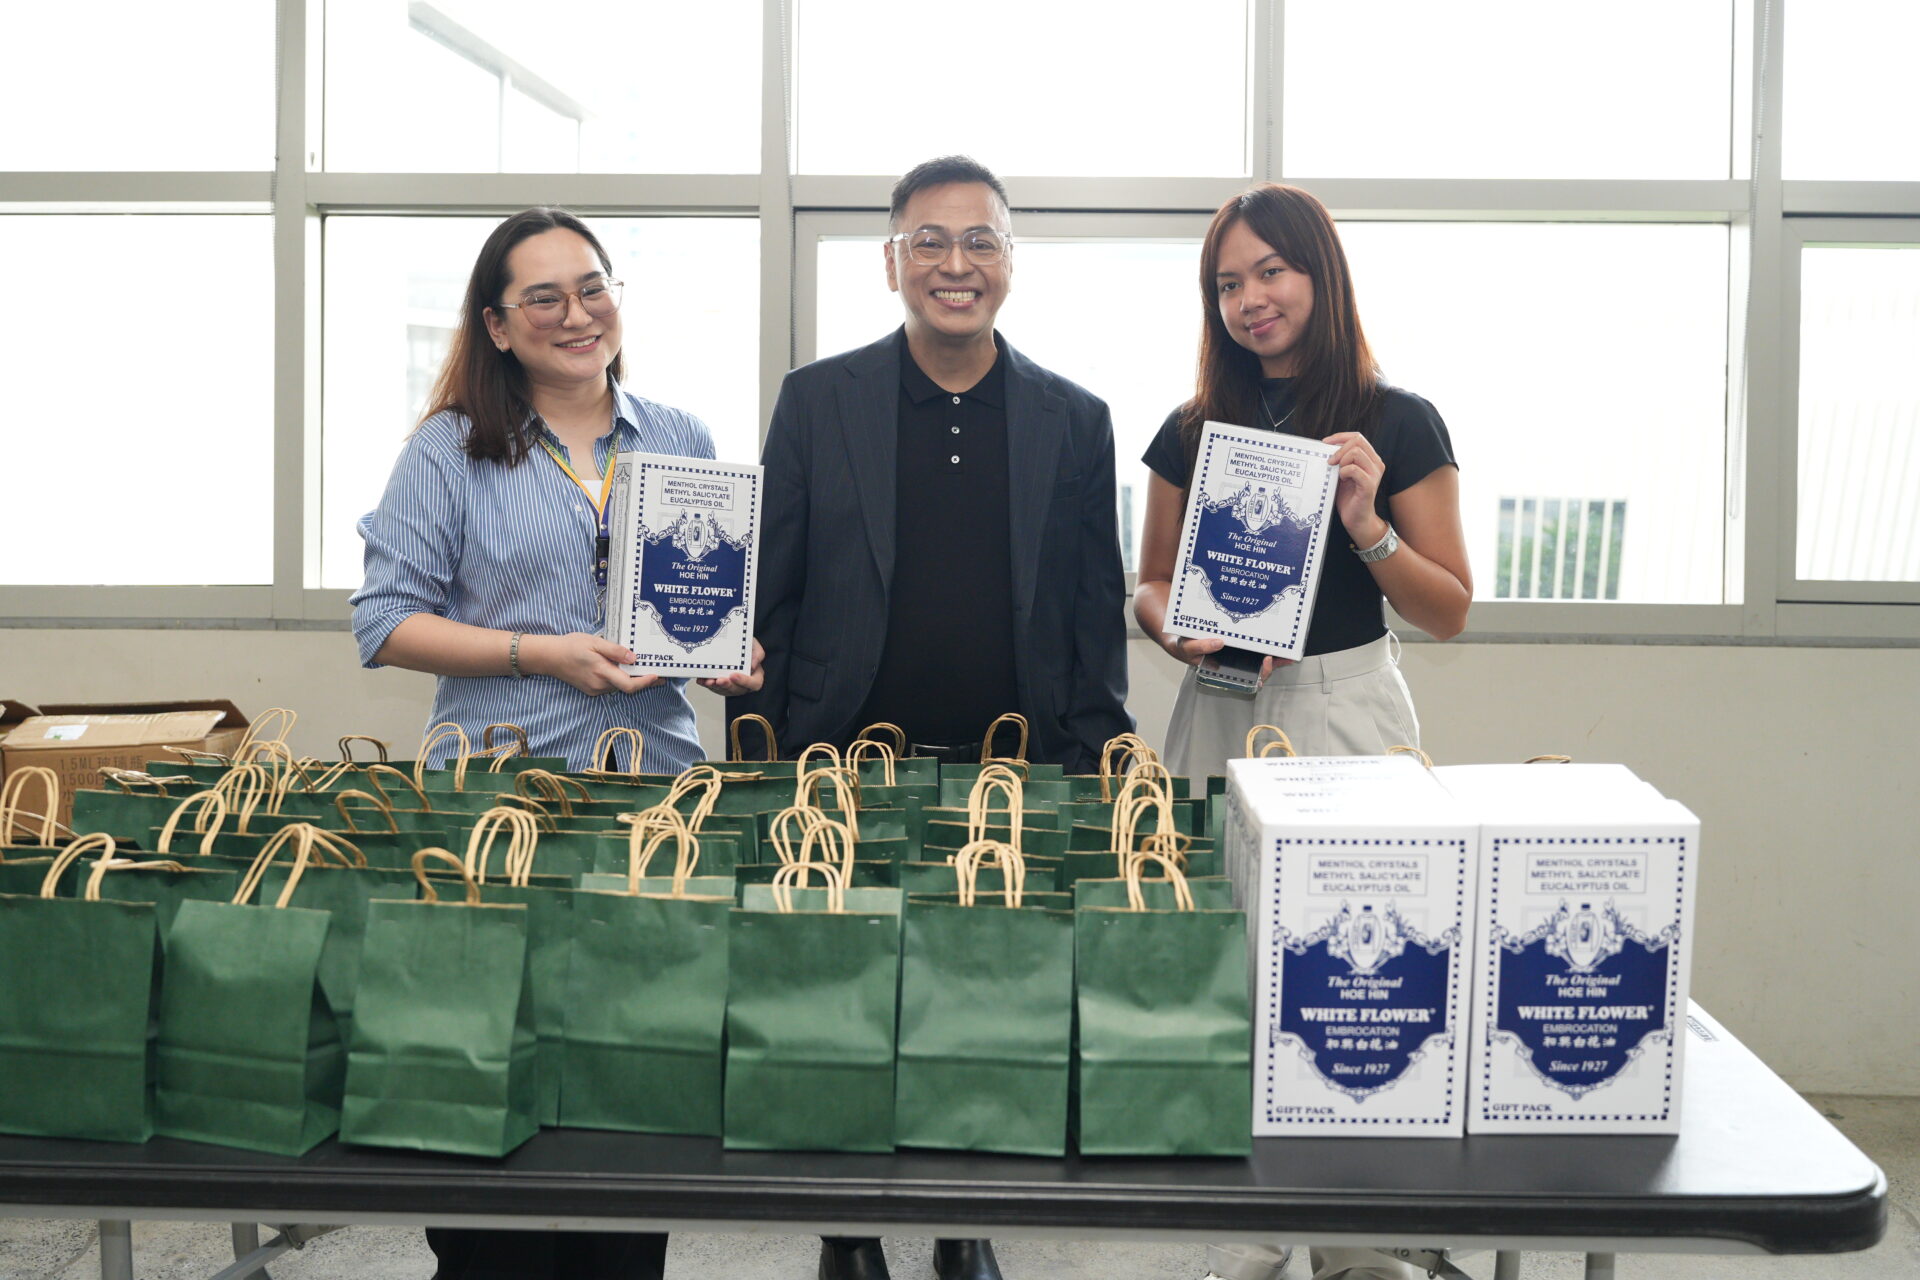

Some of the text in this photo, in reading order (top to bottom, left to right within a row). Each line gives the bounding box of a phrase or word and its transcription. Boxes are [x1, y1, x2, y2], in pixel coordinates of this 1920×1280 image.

[1234, 452, 1301, 469] MENTHOL CRYSTALS
[1229, 458, 1301, 478] METHYL SALICYLATE
[1234, 467, 1293, 485] EUCALYPTUS OIL
[667, 480, 729, 492] MENTHOL CRYSTALS
[664, 488, 730, 500] METHYL SALICYLATE
[670, 496, 724, 508] EUCALYPTUS OIL
[1227, 532, 1278, 548] The Original
[1234, 542, 1267, 555] HOE HIN
[1206, 550, 1244, 566] WHITE
[671, 562, 718, 573] The Original
[1220, 565, 1270, 581] EMBROCATION
[653, 583, 690, 595] WHITE
[669, 597, 716, 606] EMBROCATION
[1220, 592, 1260, 606] Since 1927
[1180, 614, 1218, 628] GIFT PACK
[672, 624, 709, 633] Since 1927
[1318, 860, 1418, 869] MENTHOL CRYSTALS
[1536, 859, 1638, 867] MENTHOL CRYSTALS
[1313, 872, 1421, 880] METHYL SALICYLATE
[1531, 870, 1640, 878] METHYL SALICYLATE
[1323, 884, 1411, 892] EUCALYPTUS OIL
[1540, 882, 1630, 891] EUCALYPTUS OIL
[1328, 976, 1404, 989] The Original
[1545, 974, 1622, 987] The Original
[1340, 989, 1389, 1000] HOE HIN
[1558, 987, 1607, 998] HOE HIN
[1300, 1007, 1357, 1022] WHITE
[1517, 1006, 1575, 1020] WHITE
[1325, 1026, 1400, 1036] EMBROCATION
[1542, 1024, 1618, 1034] EMBROCATION
[1332, 1063, 1390, 1075] Since 1927
[1548, 1060, 1608, 1072] Since 1927
[1276, 1106, 1335, 1114] GIFT PACK
[1492, 1104, 1552, 1112] GIFT PACK
